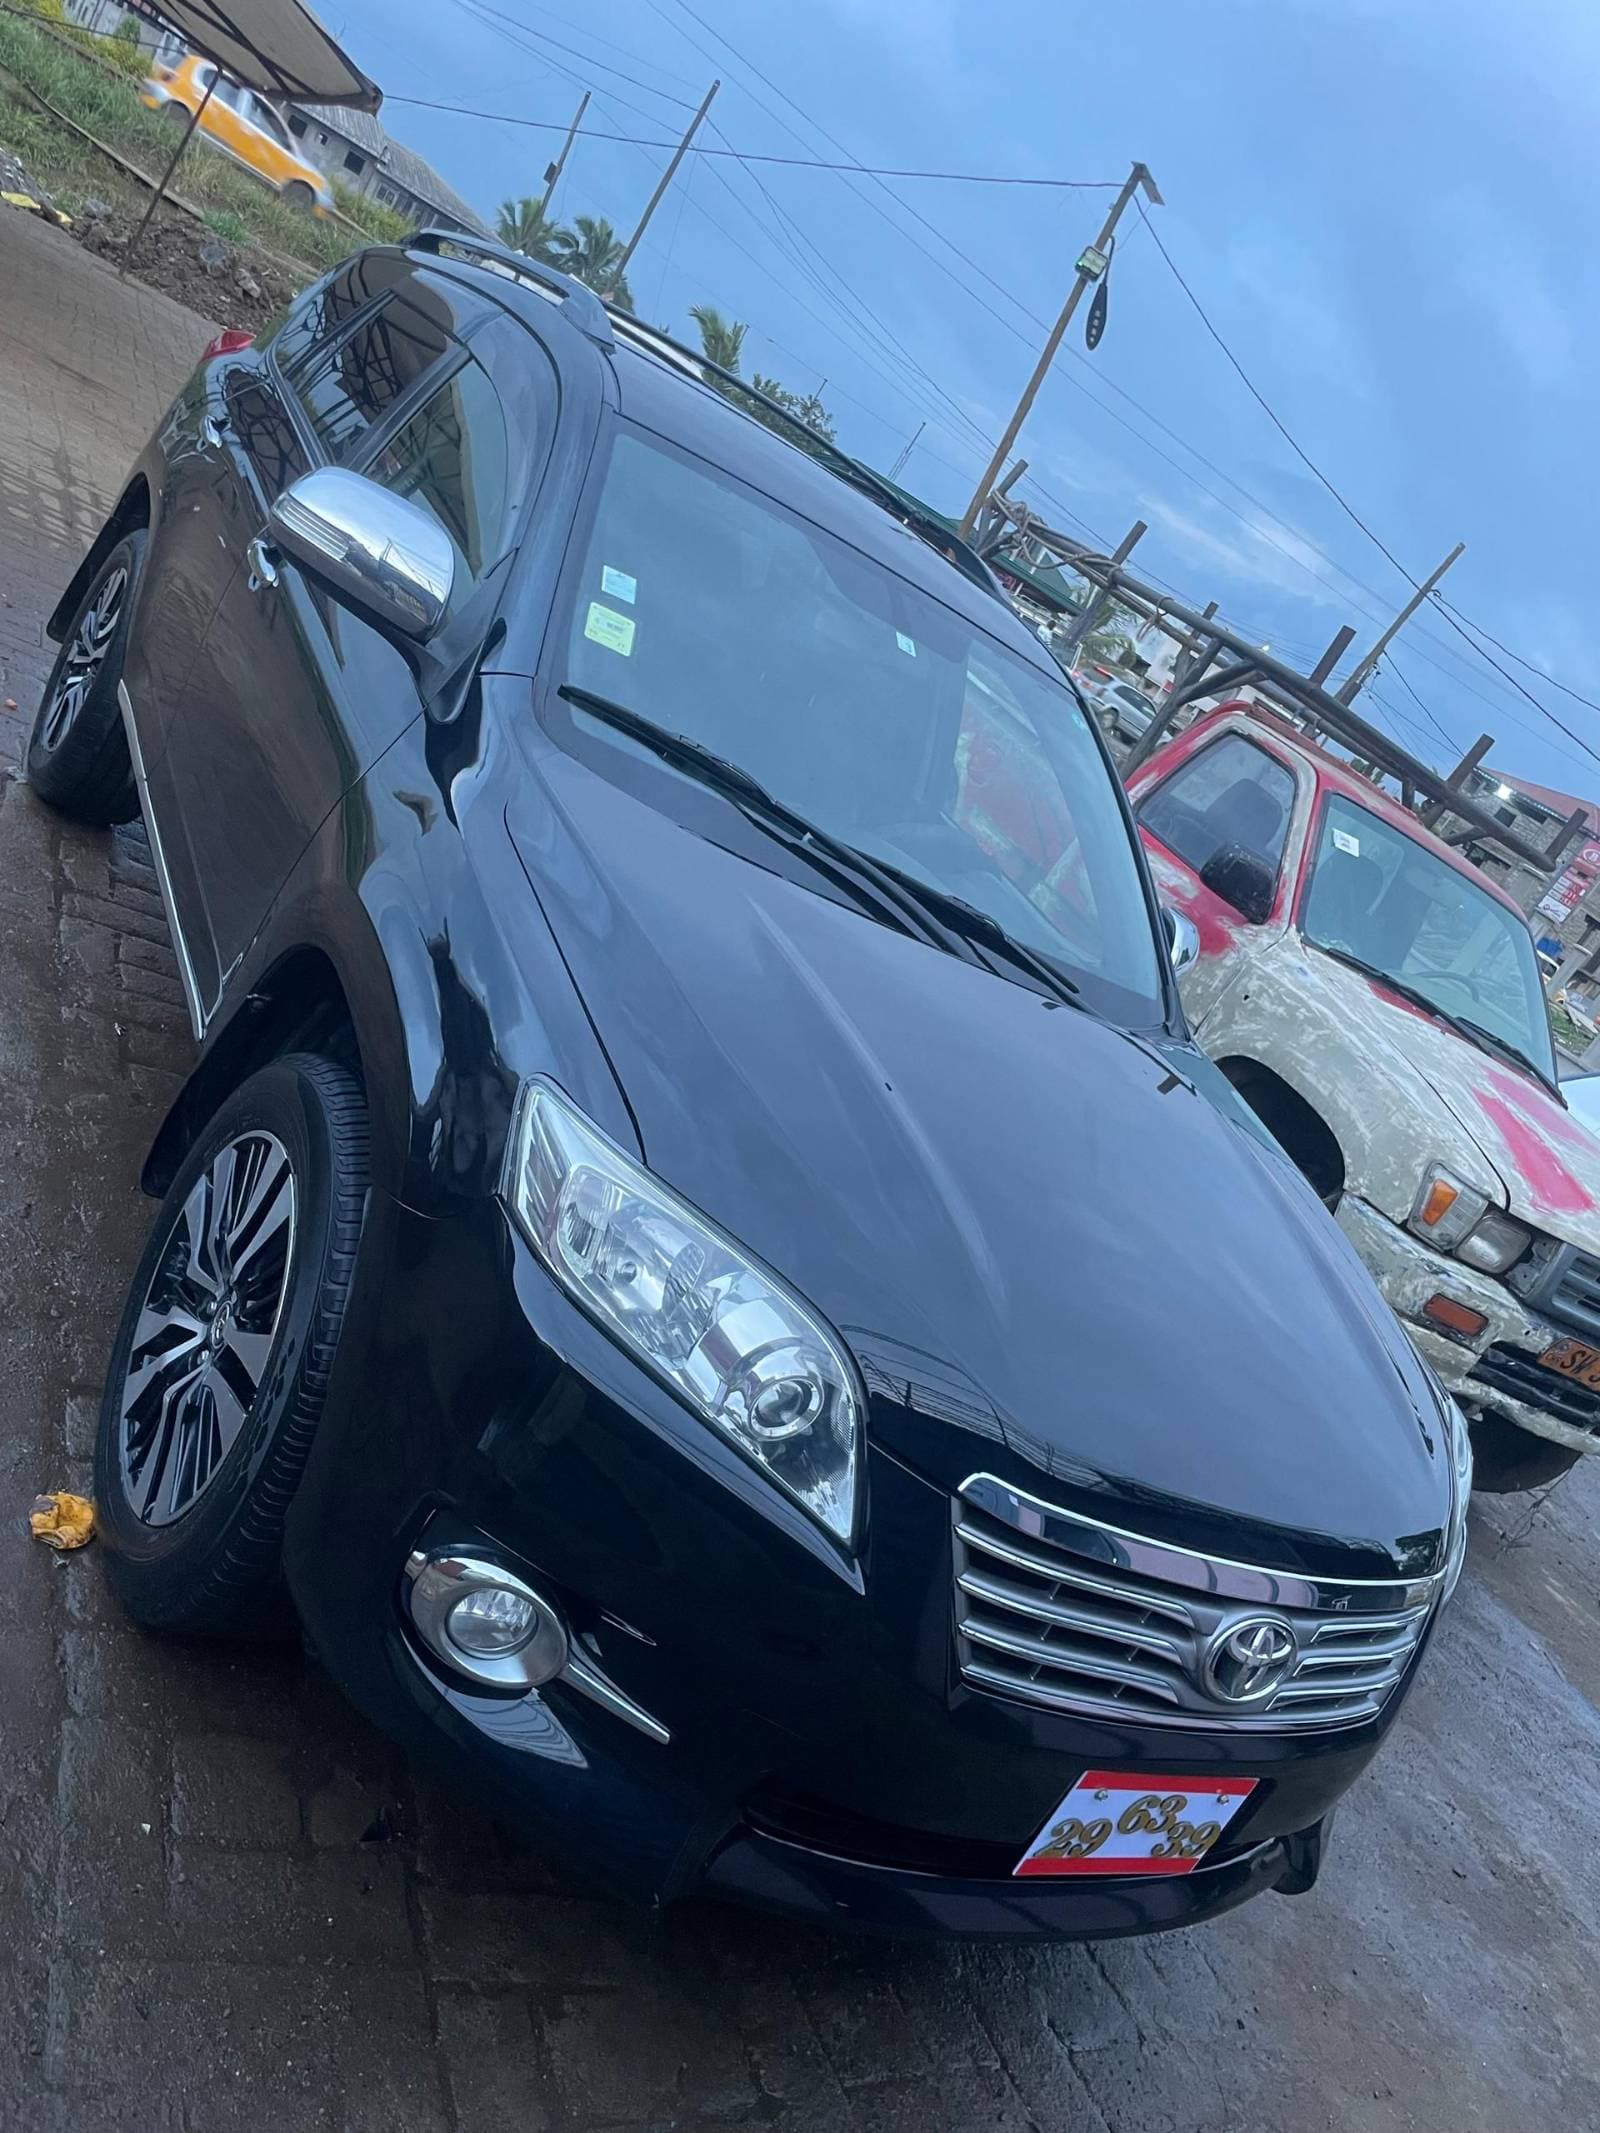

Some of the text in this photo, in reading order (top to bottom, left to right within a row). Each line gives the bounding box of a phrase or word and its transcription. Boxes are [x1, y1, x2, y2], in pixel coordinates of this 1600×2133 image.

[1033, 1795, 1222, 1857] 29 63 39
